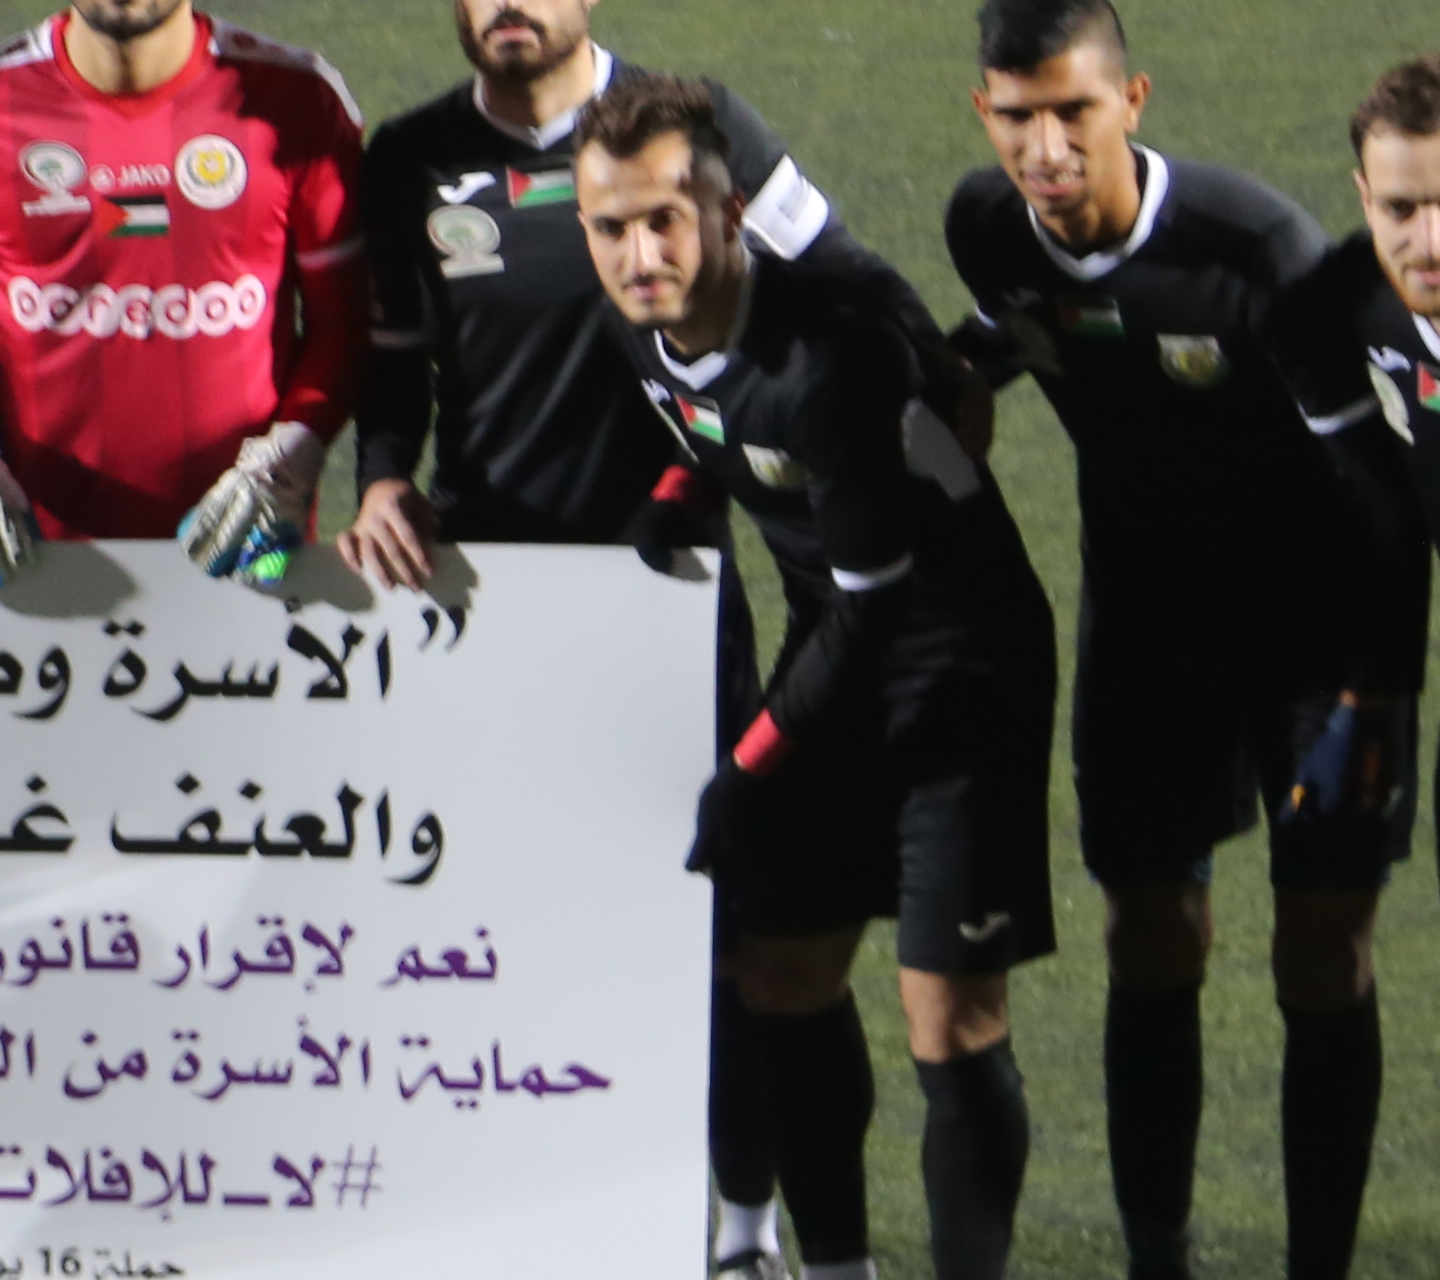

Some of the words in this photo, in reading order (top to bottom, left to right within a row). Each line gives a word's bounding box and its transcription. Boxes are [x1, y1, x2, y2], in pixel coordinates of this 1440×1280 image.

[120, 163, 170, 189] JAKO
[8, 274, 267, 340] ooredoo
[108, 771, 446, 887] والعنف
[151, 914, 356, 993] لإقرار
[382, 925, 499, 988] نعم
[62, 1030, 149, 1102] من
[171, 1017, 372, 1103] الأسرة
[398, 1034, 613, 1111] حماية
[38, 1245, 83, 1278] 16
